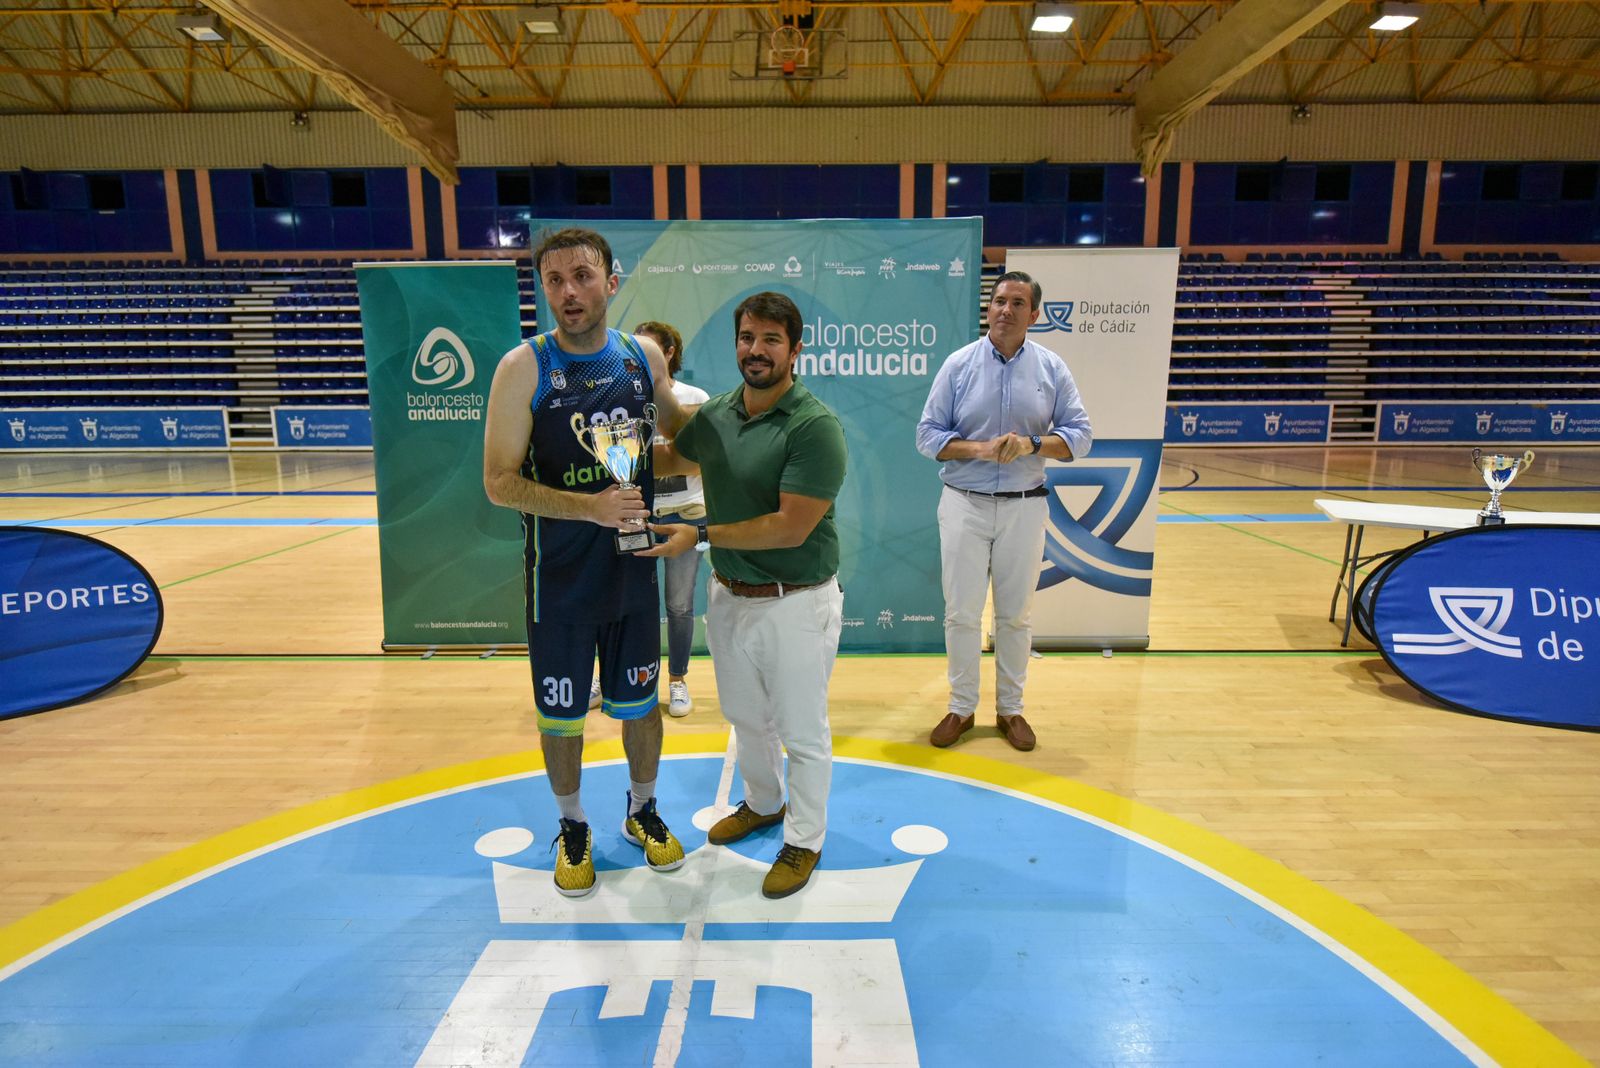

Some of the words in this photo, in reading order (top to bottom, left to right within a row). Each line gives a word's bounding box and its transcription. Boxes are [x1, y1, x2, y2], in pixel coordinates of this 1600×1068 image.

[745, 263, 775, 272] COVAP
[1080, 301, 1150, 316] Diputación
[1079, 319, 1095, 333] de
[1100, 319, 1136, 333] Cádiz
[800, 316, 937, 347] aloncesto
[793, 348, 928, 376] ndalucía
[407, 391, 484, 407] baloncesto
[1200, 419, 1243, 427] Ayuntamiento
[1411, 418, 1454, 426] Ayuntamiento
[28, 425, 69, 433] Ayuntamiento
[100, 424, 141, 432] Ayuntamiento
[181, 424, 222, 432] Ayuntamiento
[307, 423, 350, 431] Ayuntamiento
[1207, 427, 1238, 435] Algeciras
[1290, 427, 1321, 435] Algeciras
[1419, 426, 1449, 434] Algeciras
[1501, 426, 1532, 434] Algeciras
[37, 432, 67, 441] Algeciras
[109, 432, 138, 440] Algeciras
[189, 432, 219, 440] Algeciras
[316, 431, 346, 439] Algeciras
[1, 582, 150, 615] EPORTES
[1536, 631, 1585, 661] de
[543, 676, 574, 708] 30
